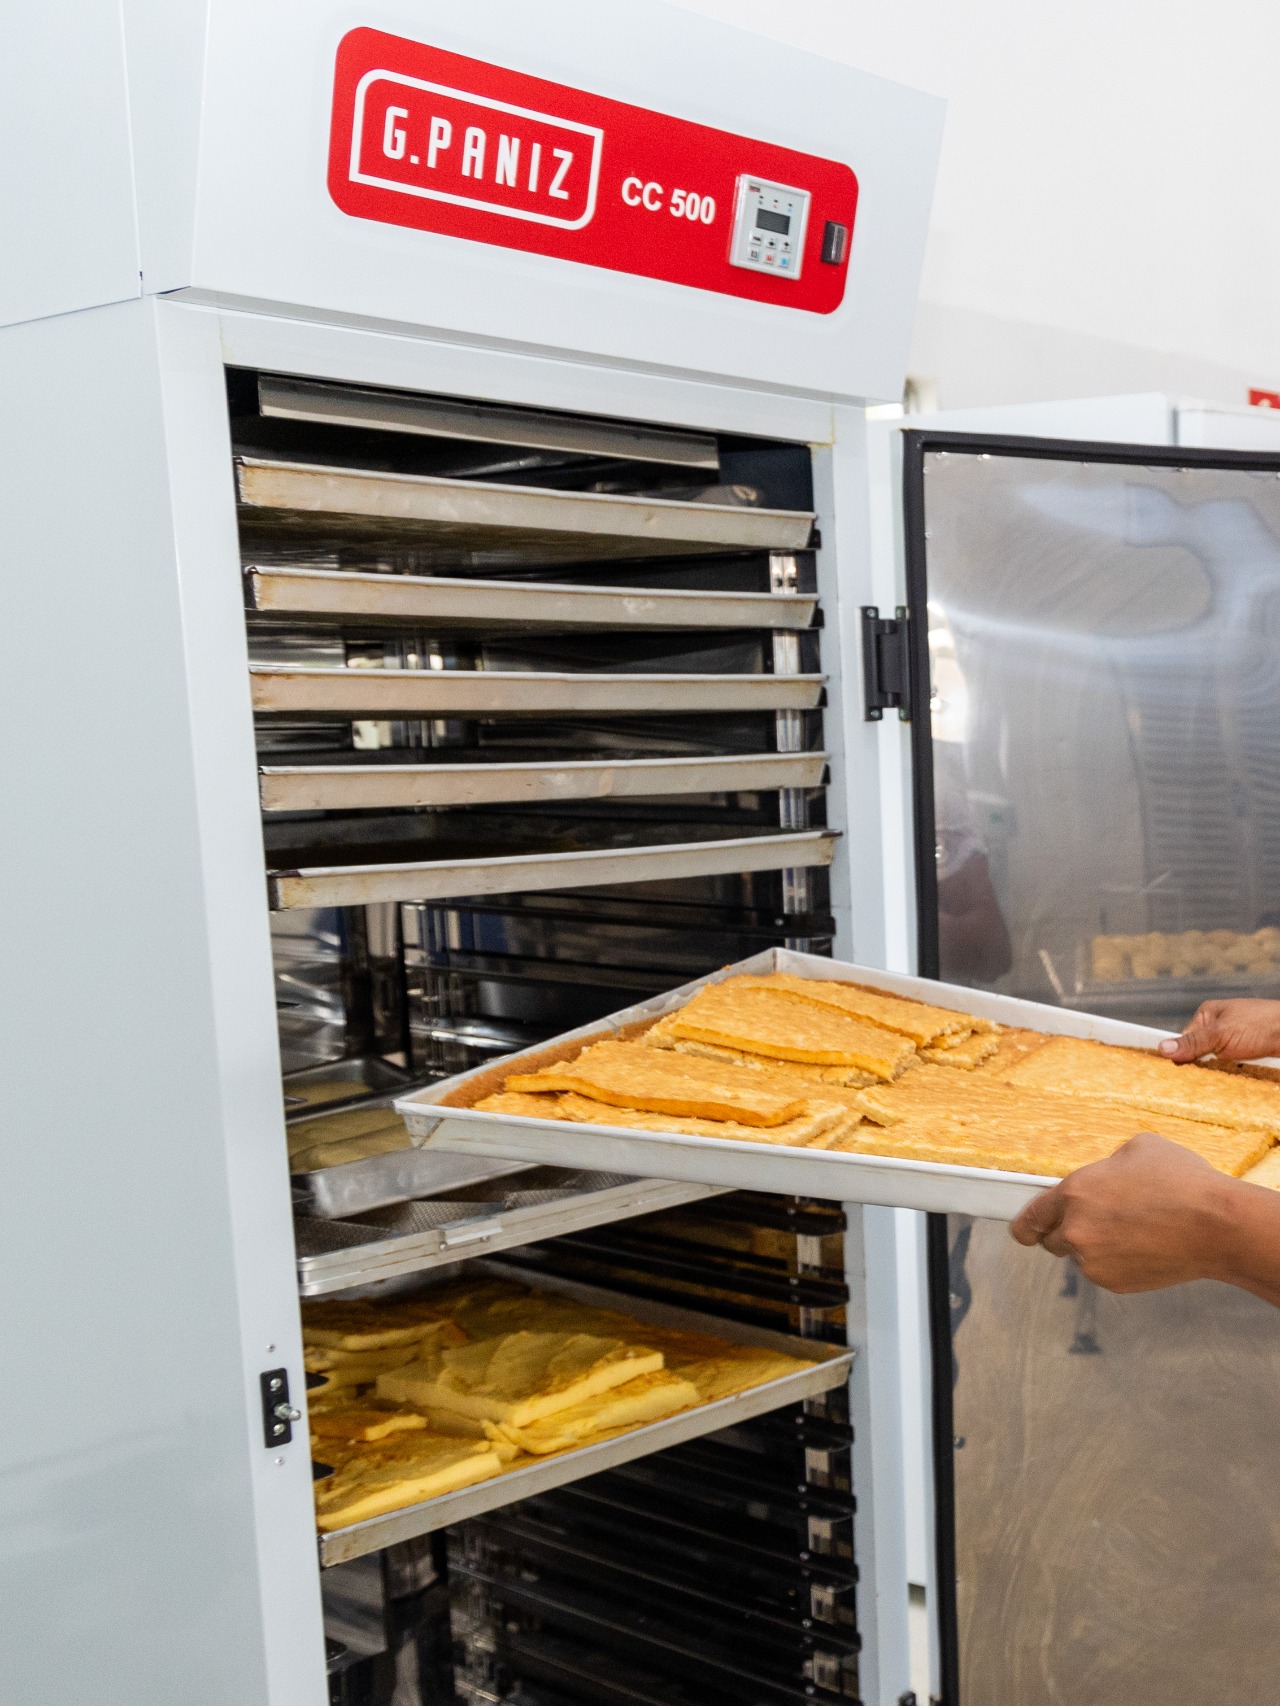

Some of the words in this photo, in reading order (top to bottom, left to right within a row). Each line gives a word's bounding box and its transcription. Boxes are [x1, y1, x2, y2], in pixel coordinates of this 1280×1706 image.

[382, 105, 574, 200] G.PANIZ
[621, 176, 664, 212] CC
[669, 187, 716, 225] 500
